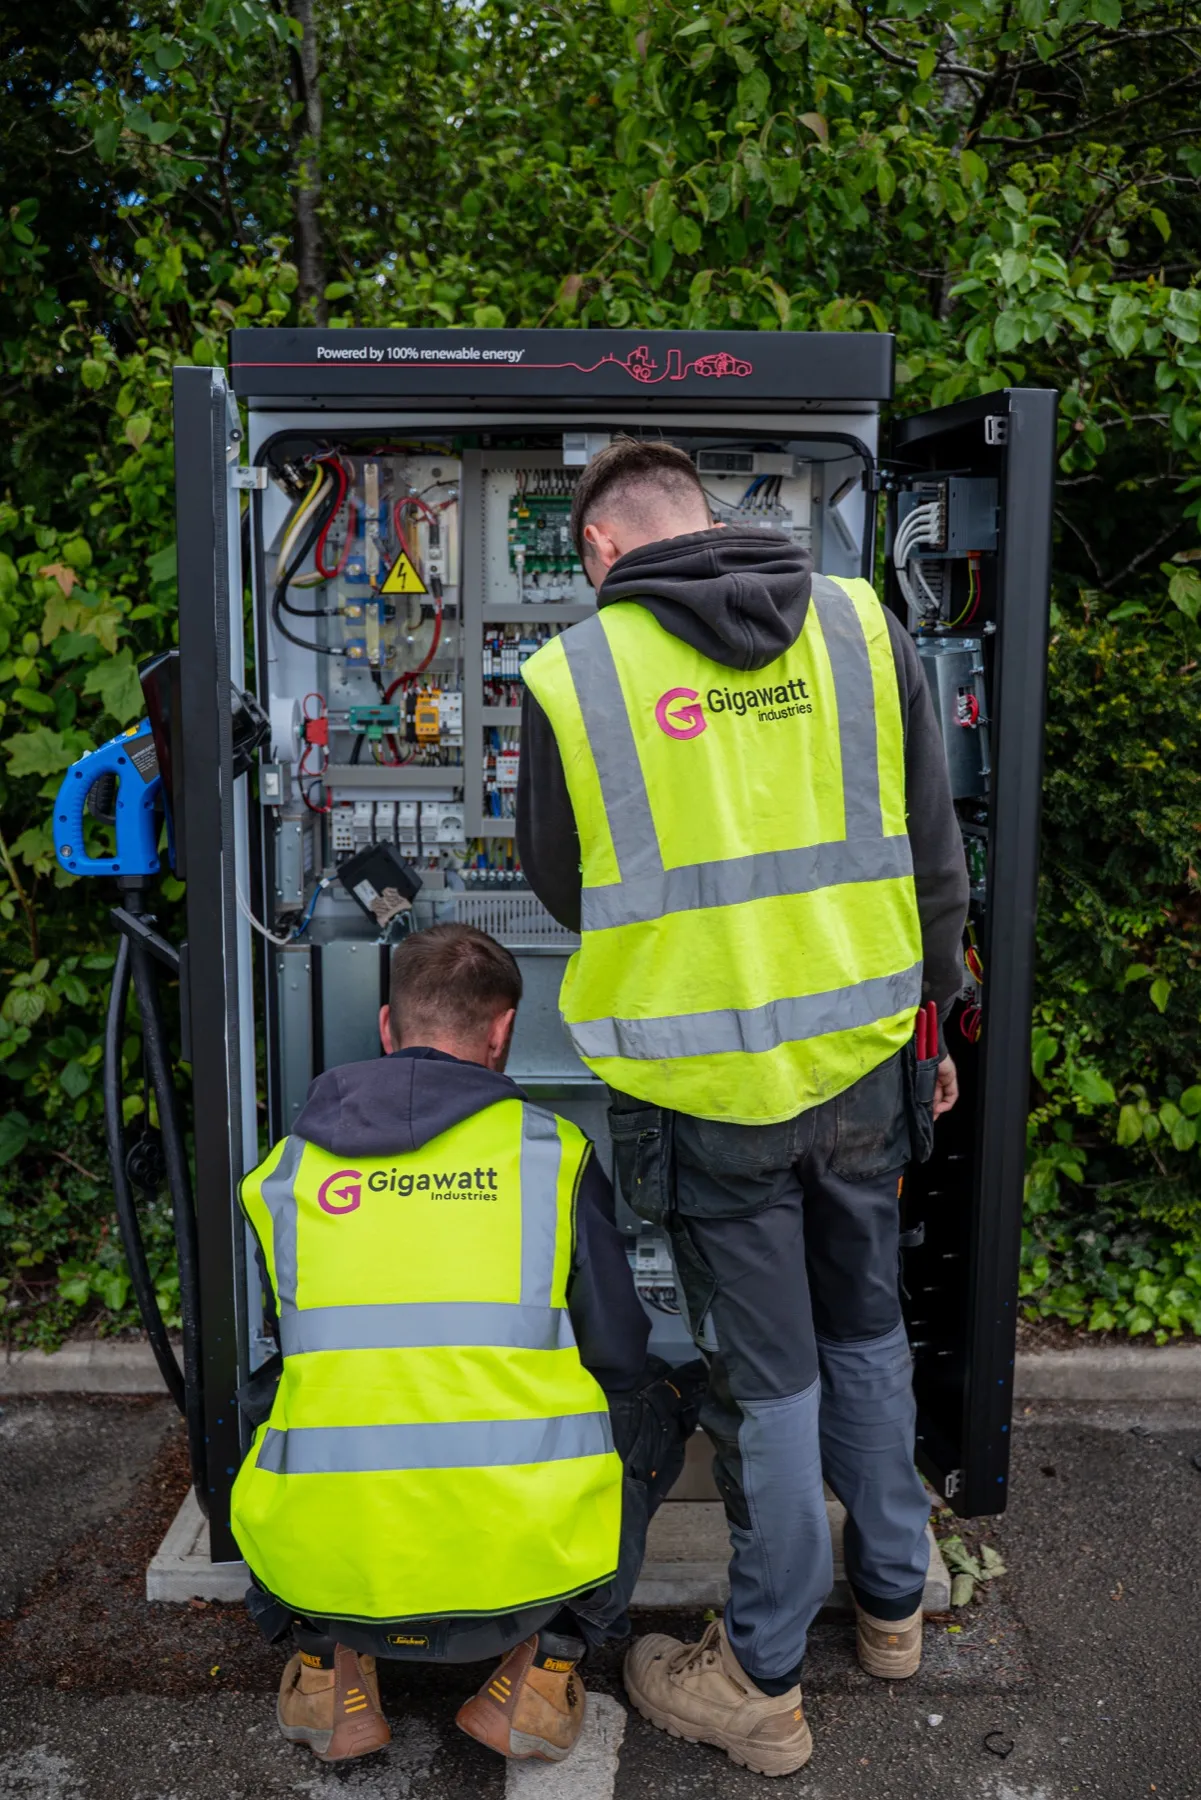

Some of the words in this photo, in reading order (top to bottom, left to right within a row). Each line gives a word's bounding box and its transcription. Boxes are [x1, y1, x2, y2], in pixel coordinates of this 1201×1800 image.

[317, 347, 367, 359] Powered
[369, 347, 384, 361] by
[387, 347, 419, 359] 100%
[420, 347, 481, 359] renewable
[707, 678, 809, 716] Gigawatt
[368, 1167, 498, 1197] Gigawatt
[431, 1191, 498, 1201] Industries
